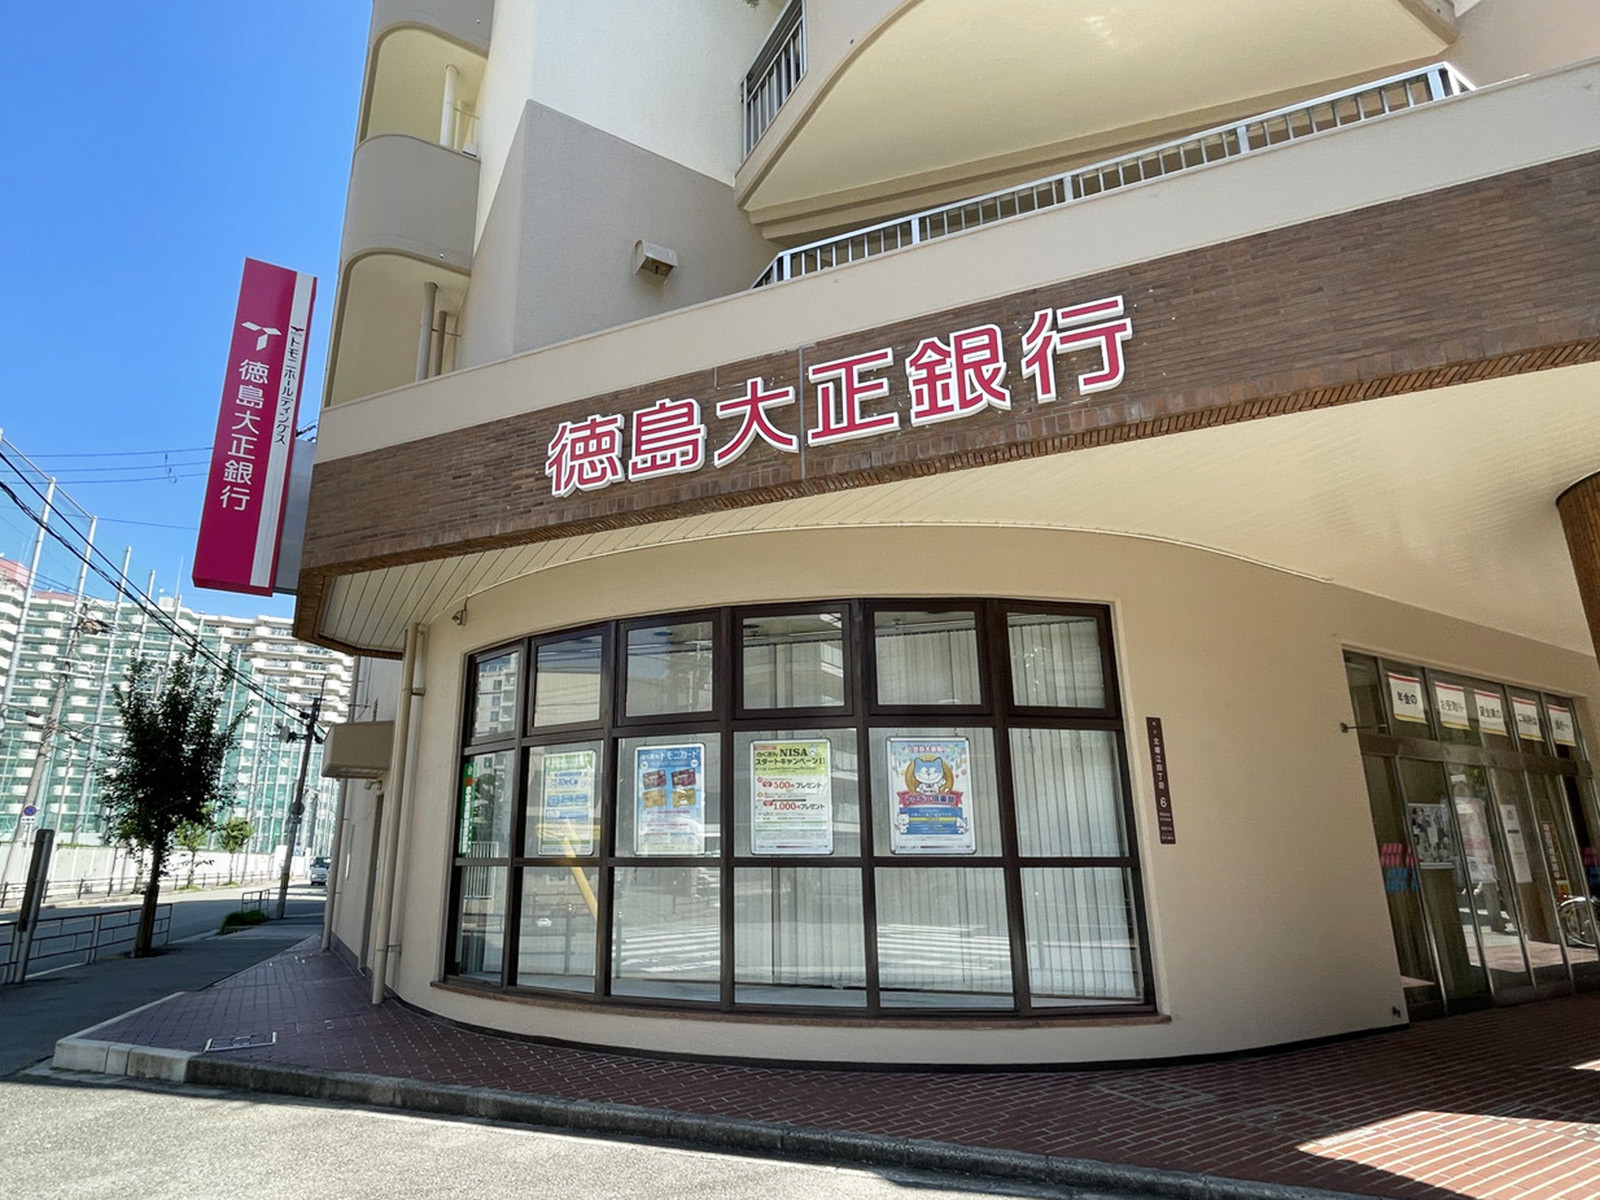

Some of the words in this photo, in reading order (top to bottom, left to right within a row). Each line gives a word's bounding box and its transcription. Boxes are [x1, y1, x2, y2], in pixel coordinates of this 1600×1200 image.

[220, 358, 270, 511] 徳島大正銀行
[274, 336, 301, 445] トモニホールディングス
[546, 295, 1133, 498] 徳島大正銀行
[779, 748, 808, 757] NISA
[1160, 797, 1167, 808] 6
